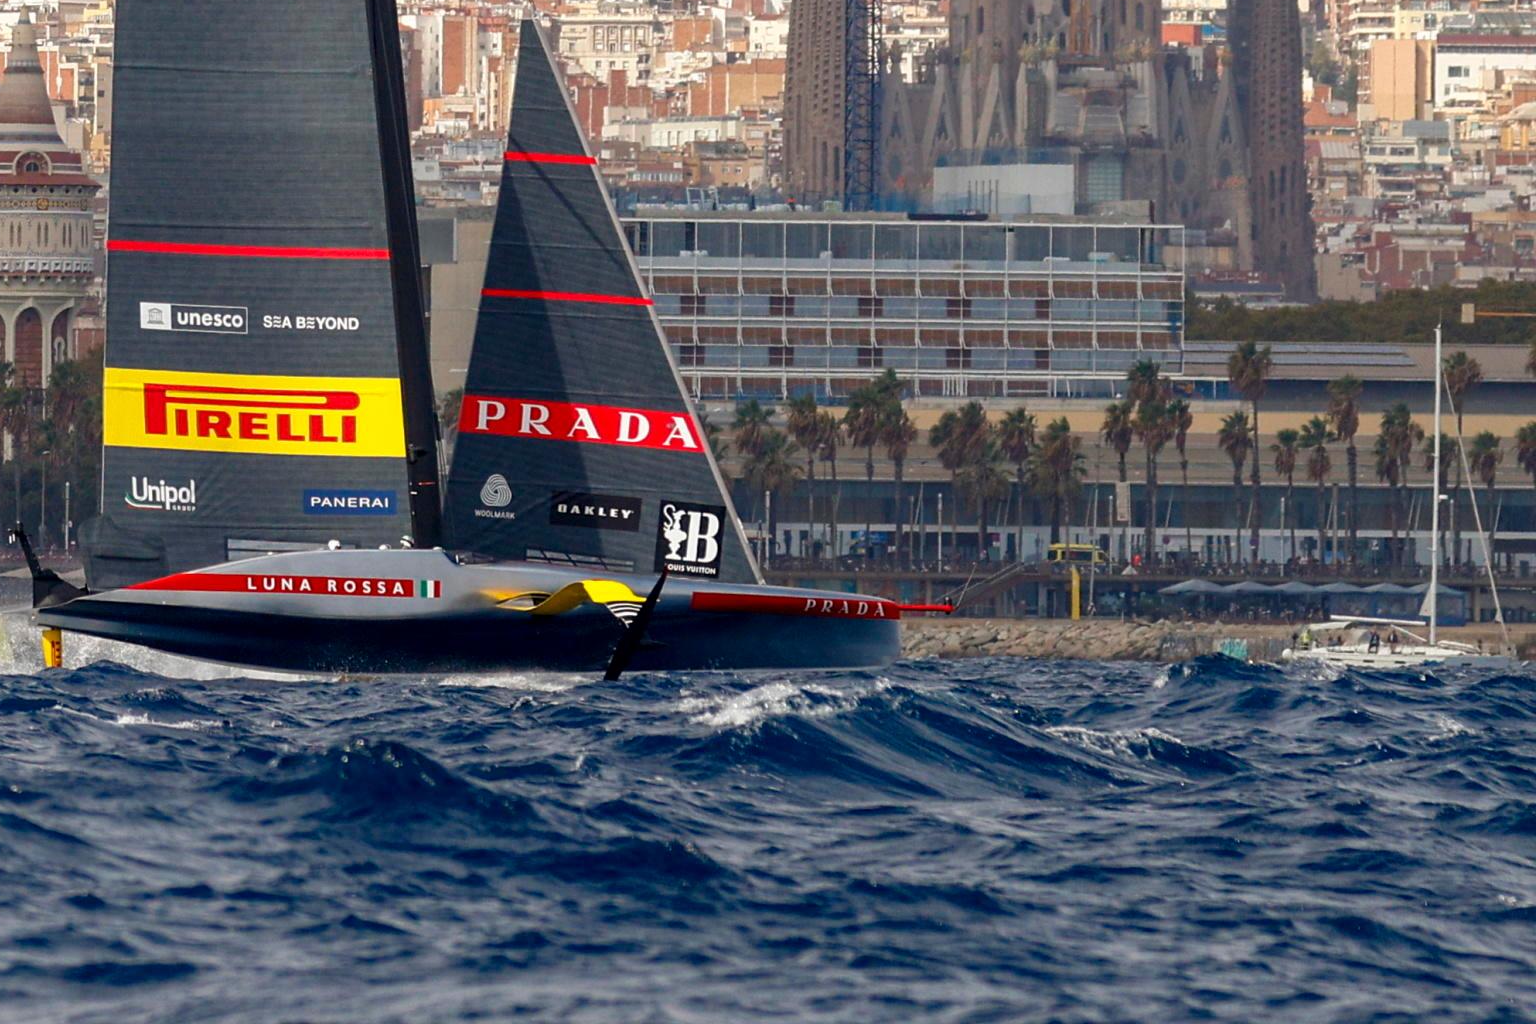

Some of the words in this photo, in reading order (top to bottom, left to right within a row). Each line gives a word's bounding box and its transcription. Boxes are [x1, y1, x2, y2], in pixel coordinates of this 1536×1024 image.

[177, 310, 244, 328] unesco
[144, 382, 361, 443] PIRELLI
[476, 400, 698, 449] PRADA
[131, 476, 196, 510] Unipol
[310, 496, 389, 509] PANERAI
[557, 503, 634, 519] OAKLEY
[475, 508, 515, 519] WOOLMARK
[666, 563, 685, 571] OUIS
[686, 565, 716, 575] VUITTON
[247, 577, 311, 591] LUNA
[328, 580, 404, 595] ROSSA
[805, 598, 885, 617] PRADA
